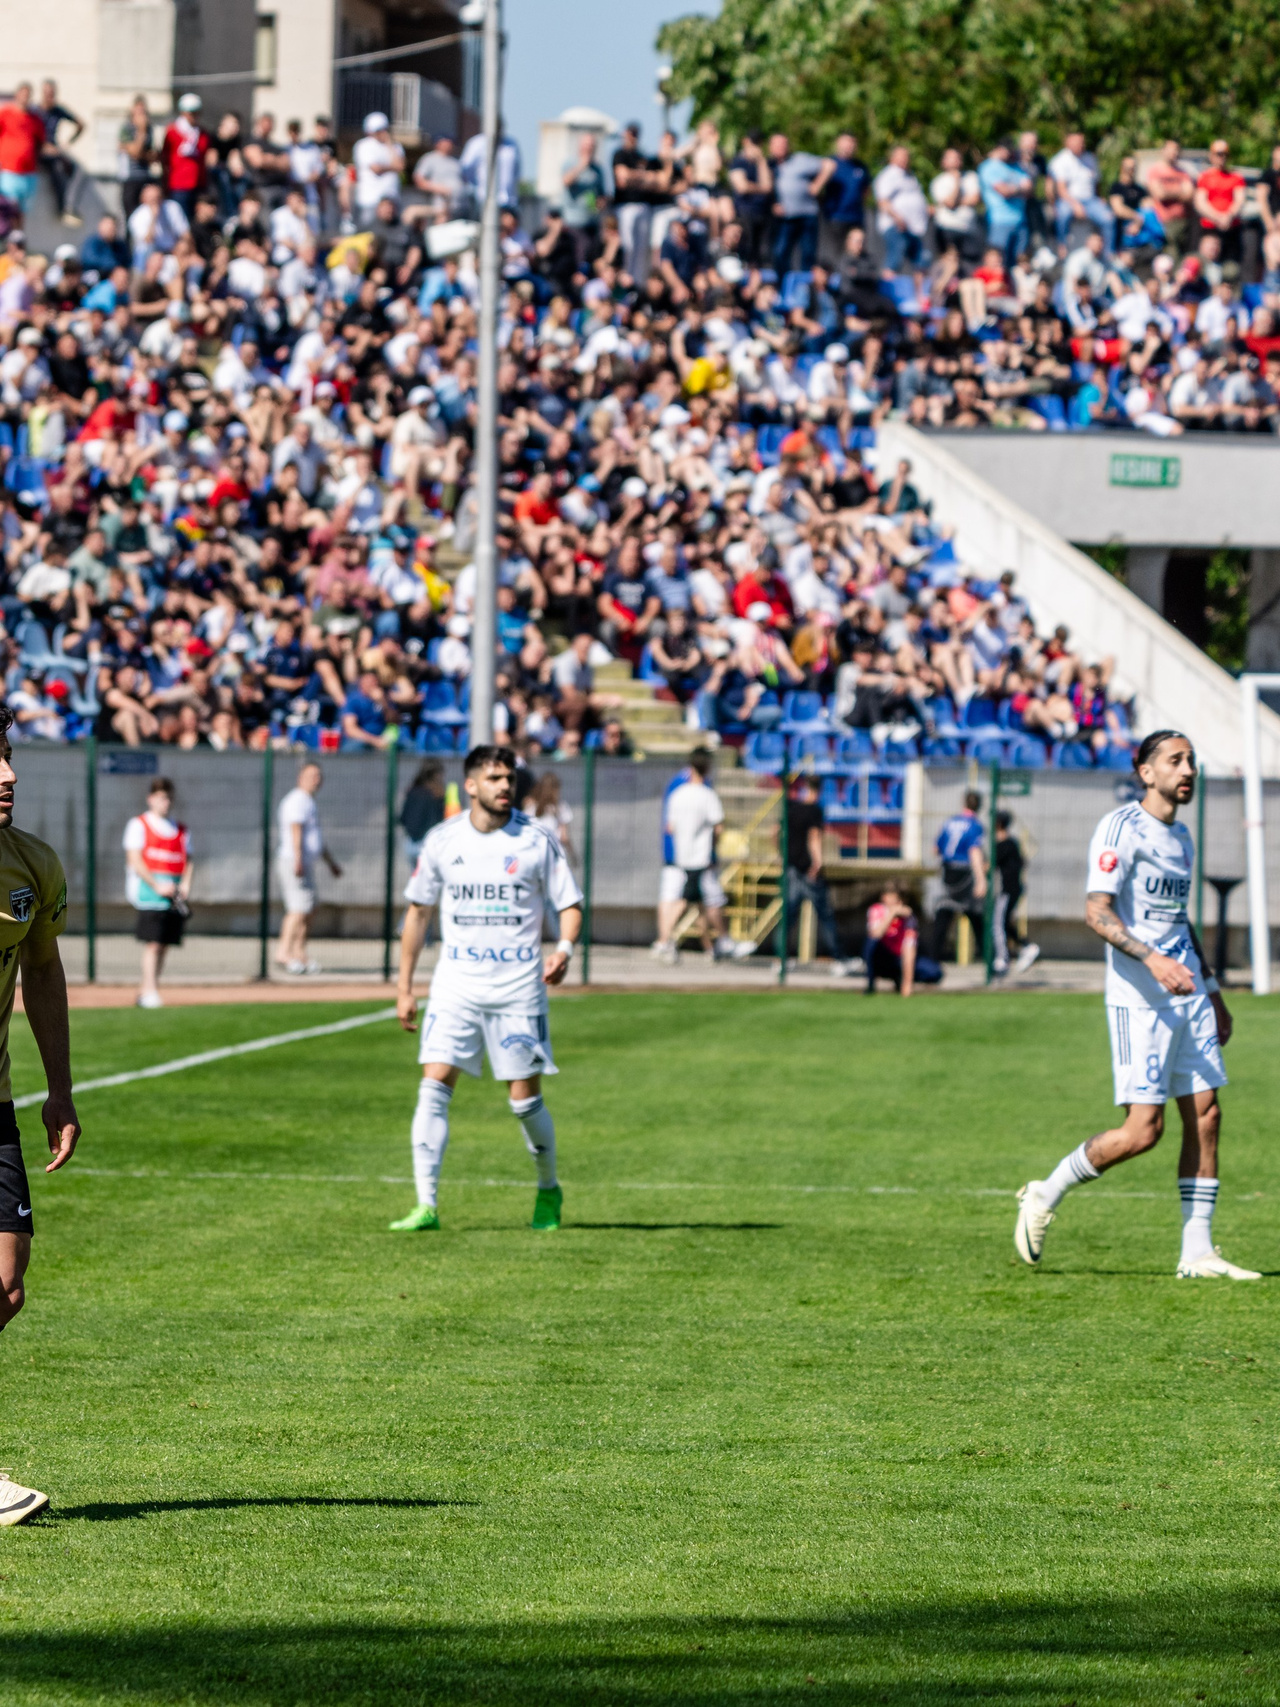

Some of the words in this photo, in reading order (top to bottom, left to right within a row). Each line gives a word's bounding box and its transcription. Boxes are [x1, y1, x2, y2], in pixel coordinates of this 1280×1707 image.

[447, 883, 527, 900] UNIBET
[447, 946, 535, 963] ELSACO
[1146, 1053, 1163, 1084] 8
